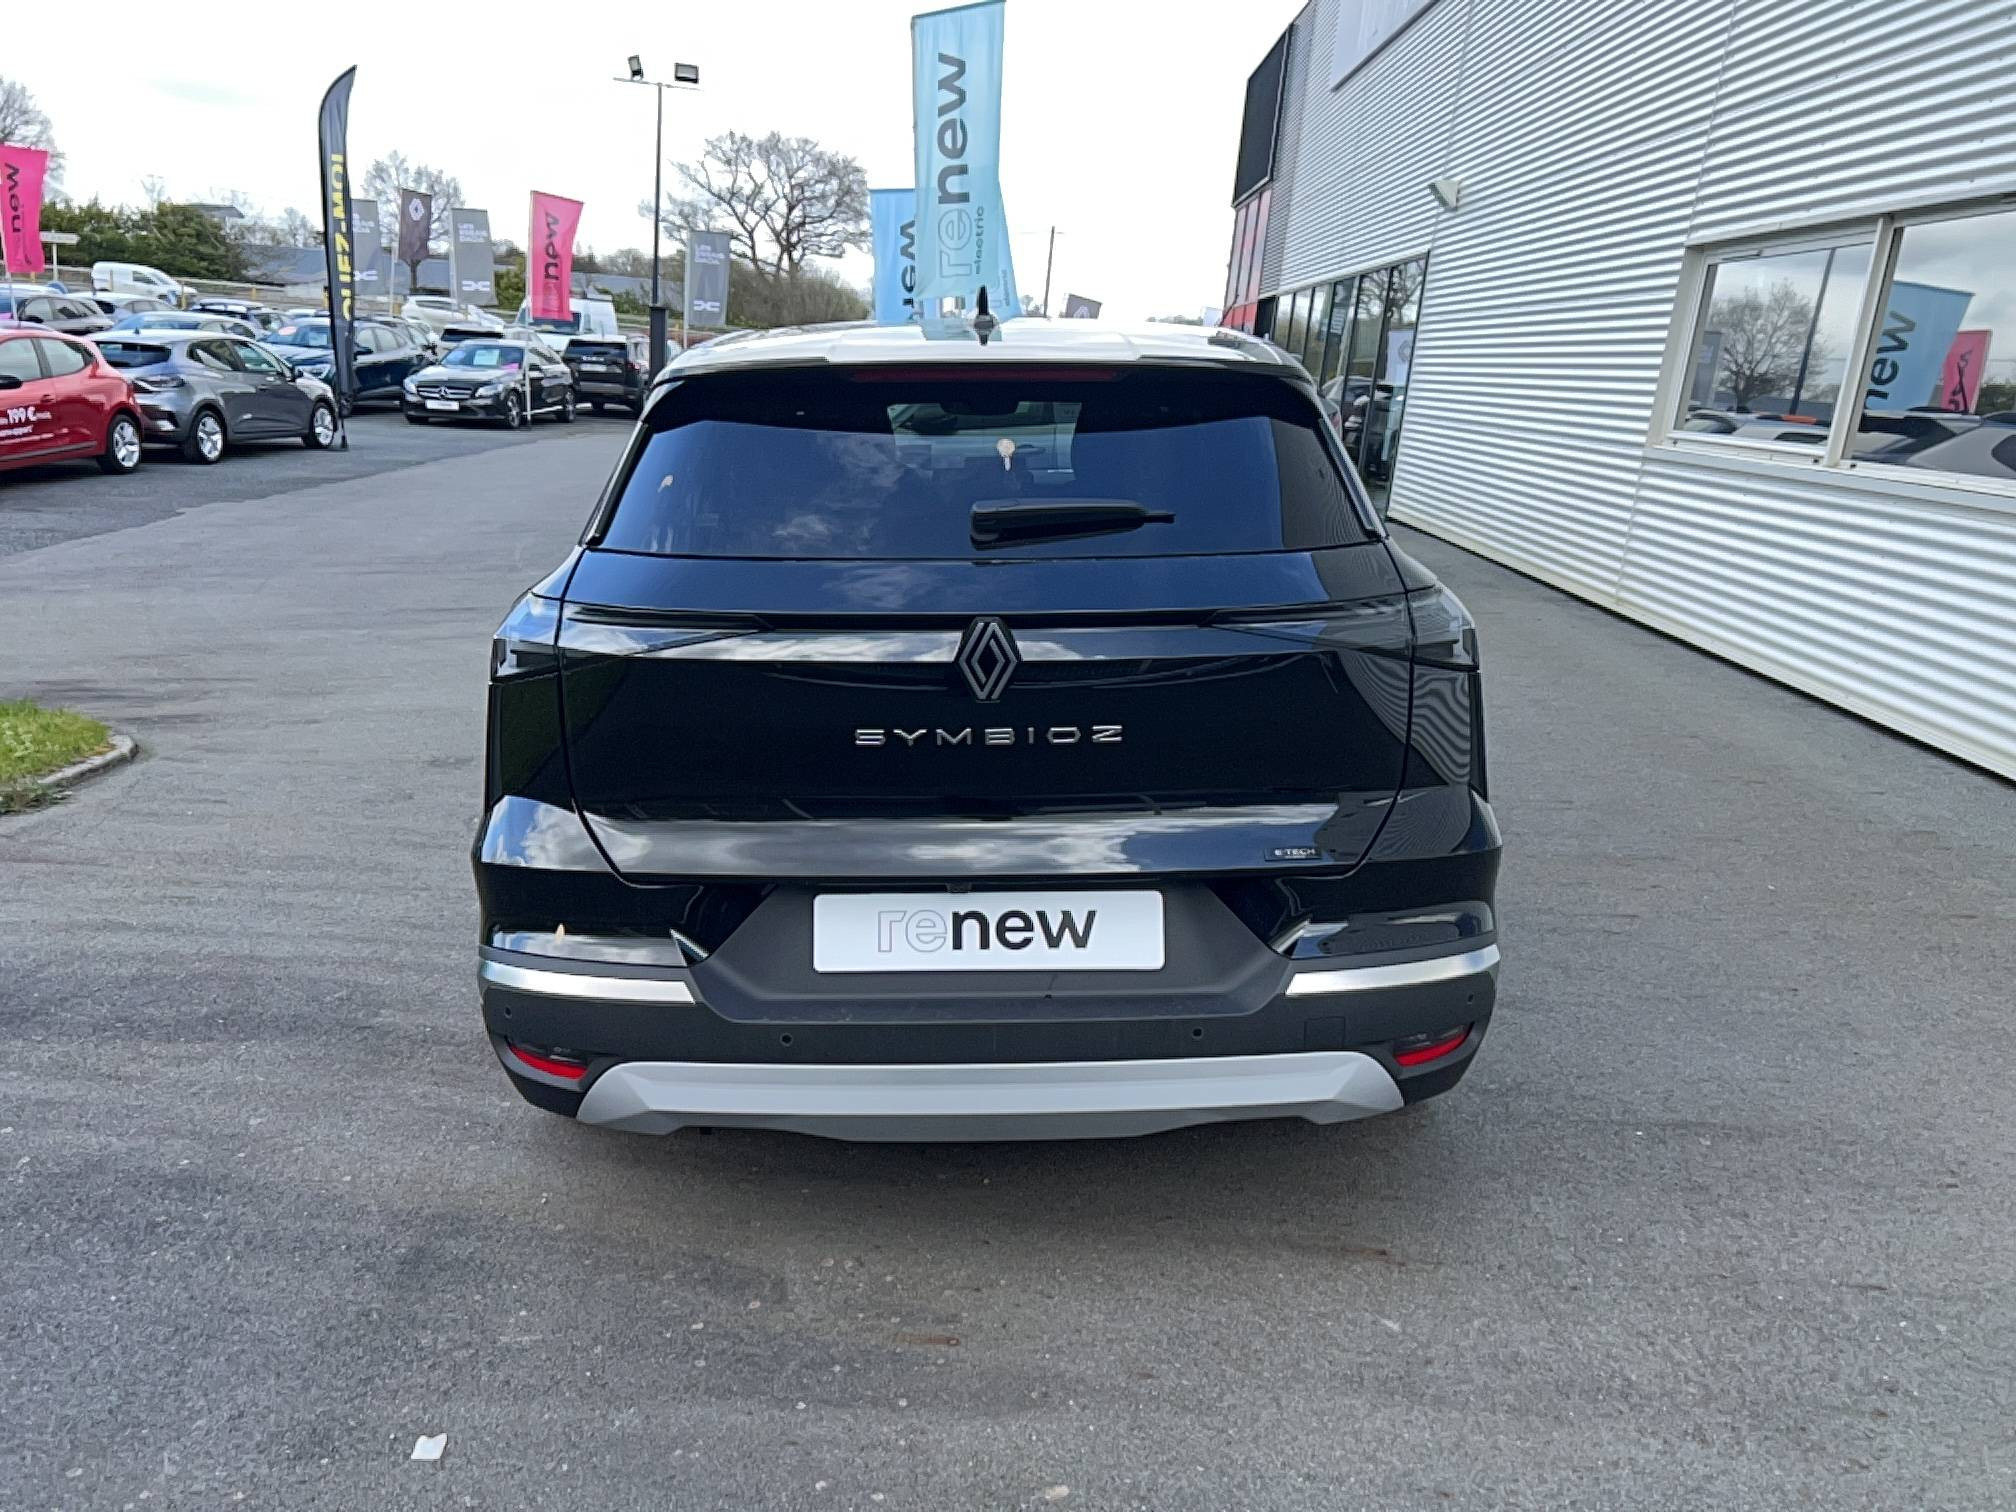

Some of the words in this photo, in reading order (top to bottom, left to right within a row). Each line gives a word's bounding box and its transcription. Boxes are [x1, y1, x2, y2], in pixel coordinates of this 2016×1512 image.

[937, 53, 973, 279] renew
[854, 724, 1125, 747] SYMBIOZ
[877, 910, 1097, 951] renew
